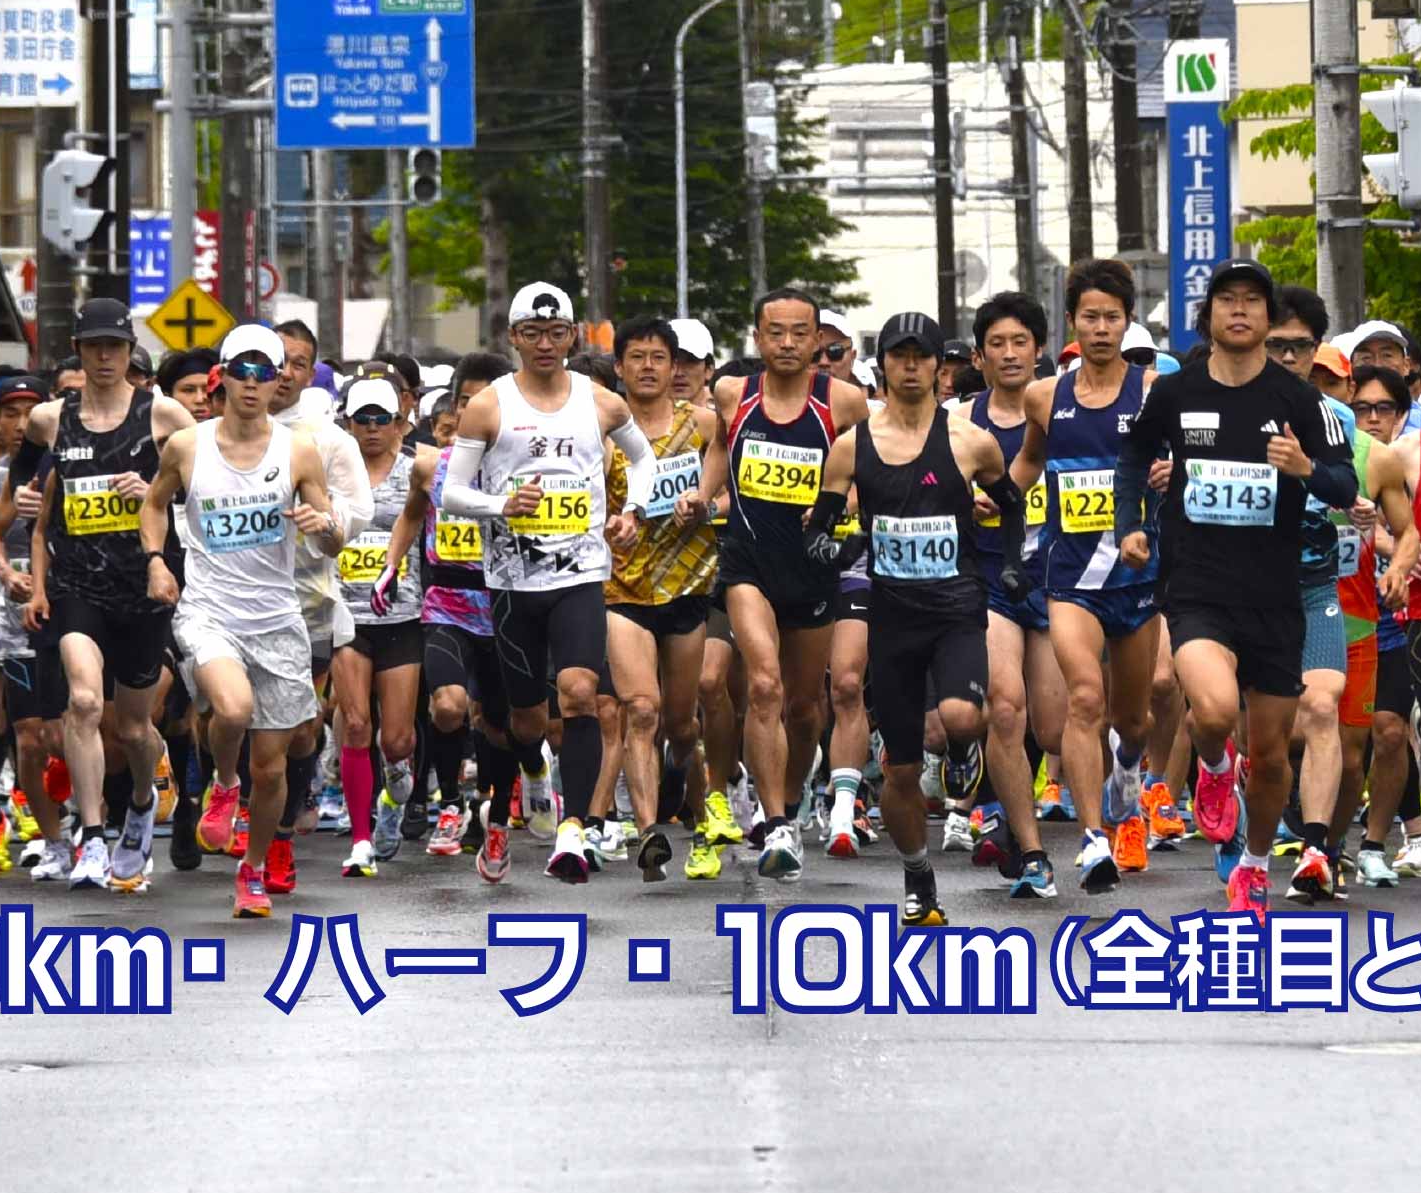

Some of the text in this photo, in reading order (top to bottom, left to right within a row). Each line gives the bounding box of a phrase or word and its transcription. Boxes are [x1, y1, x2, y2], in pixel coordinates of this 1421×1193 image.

[3, 36, 76, 61] 湯田庁舎
[320, 72, 418, 93] ほっとゆだ駅
[528, 436, 575, 458] 釜石
[1184, 430, 1216, 439] UNITED
[1066, 492, 1115, 517] A22
[1188, 482, 1272, 510] A3143
[206, 507, 281, 538] A3206
[877, 537, 955, 563] A3140
